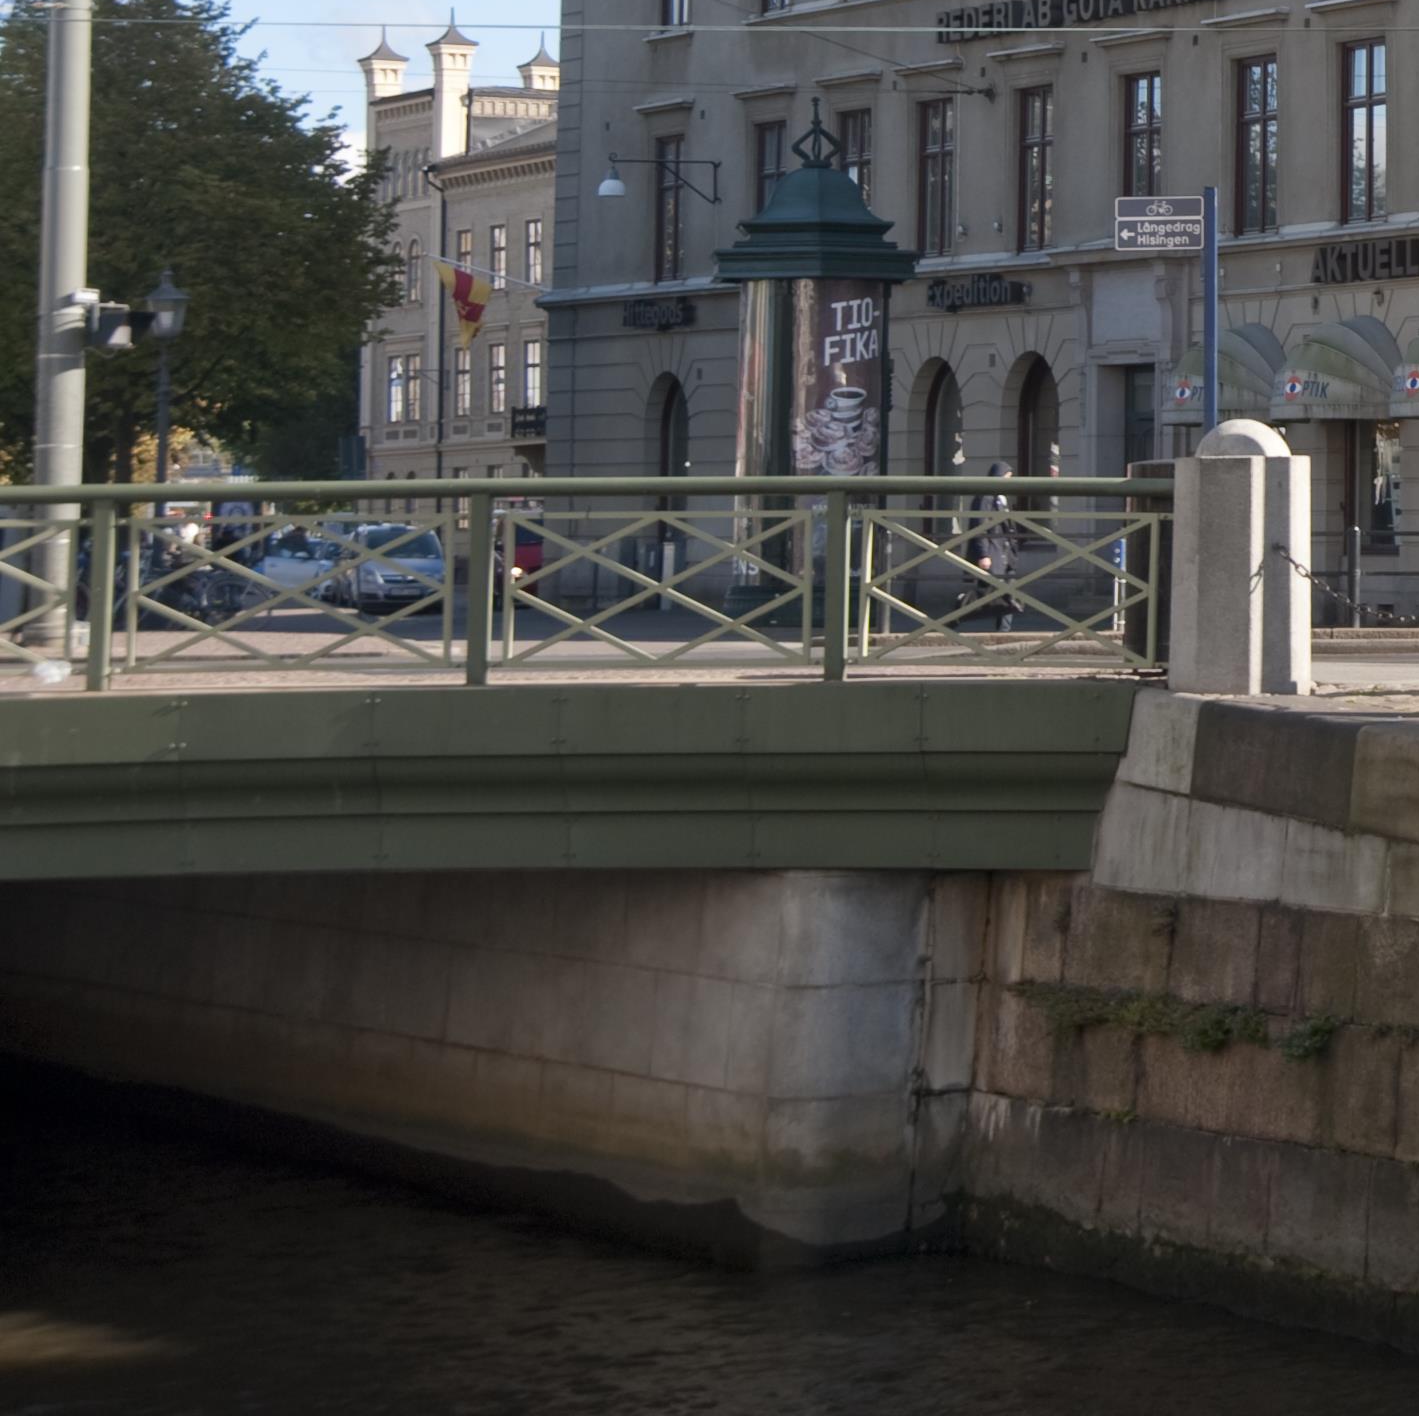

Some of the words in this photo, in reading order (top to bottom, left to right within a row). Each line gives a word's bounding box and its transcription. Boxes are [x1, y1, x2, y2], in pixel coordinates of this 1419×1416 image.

[937, 0, 1015, 43] REDERI
[1137, 222, 1200, 235] Långedrag
[1137, 234, 1189, 248] Hisingen
[928, 274, 1010, 312] Expedition
[831, 297, 880, 331] TIO-
[824, 329, 879, 366] FIKA
